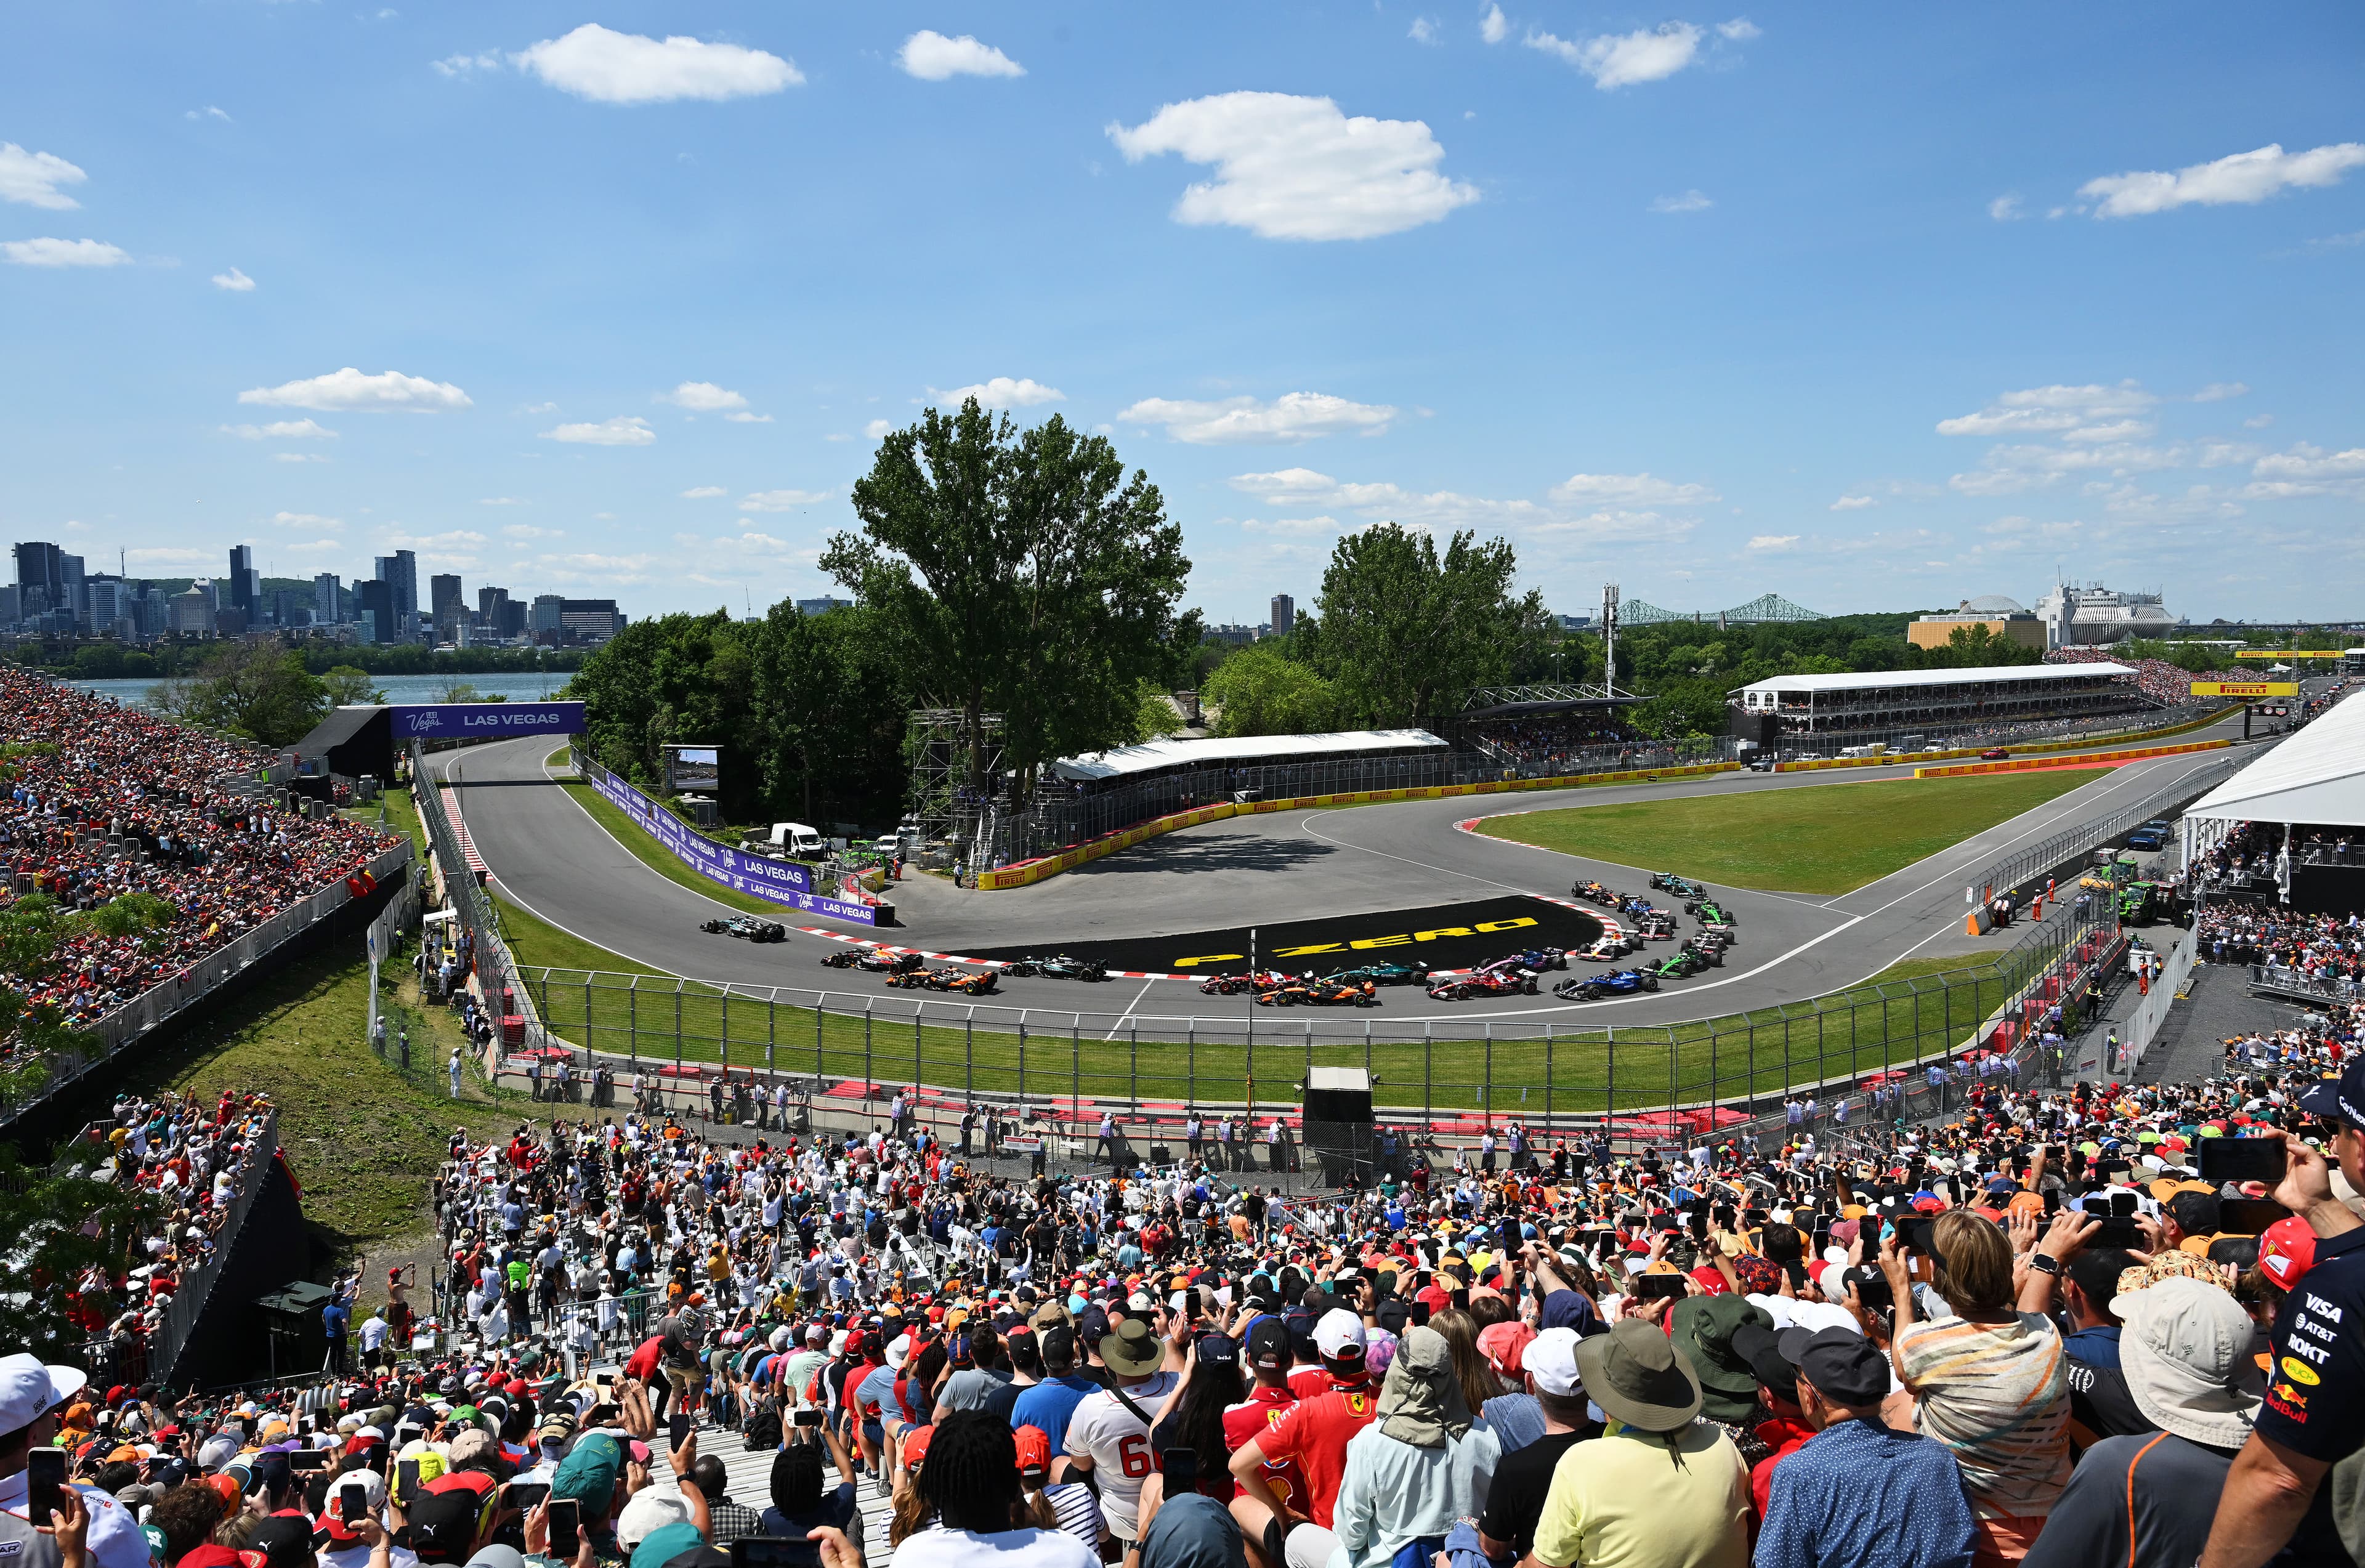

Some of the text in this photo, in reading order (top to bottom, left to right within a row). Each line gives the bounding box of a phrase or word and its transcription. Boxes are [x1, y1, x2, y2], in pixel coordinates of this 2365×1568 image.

[2220, 685, 2266, 693] PIRELLI
[406, 712, 443, 731] Vegas
[464, 714, 560, 725] LAS VEGAS
[1370, 791, 1392, 800] PIRELLI
[1406, 789, 1428, 797] PIRELLI
[1441, 787, 1462, 795] PIRELLI
[1476, 784, 1496, 792] PIRELLI
[1294, 798, 1317, 806] PIRELLI
[1332, 794, 1355, 803] PIRELLI
[1254, 802, 1277, 811] PIRELLI
[1173, 816, 1188, 828] PIRELLI
[1199, 810, 1214, 821] PIRELLI
[689, 836, 716, 858] LAS VEGAS
[1087, 844, 1101, 858] PIRELLI
[1062, 853, 1077, 867] PIRELLI
[706, 866, 729, 882] LAS VEGAS
[745, 860, 803, 884] LAS VEGAS
[1037, 862, 1052, 878] PIRELLI
[995, 871, 1025, 886] PIRELLI
[751, 883, 790, 901] LAS VEGAS
[798, 894, 814, 909] Vegas
[823, 902, 871, 919] LAS VEGAS
[1174, 917, 1538, 967] P ZERO
[2306, 1292, 2342, 1324] VISA
[2304, 1321, 2337, 1342] AT&T
[2288, 1333, 2331, 1364] ROKT
[146, 1530, 162, 1548] 14
